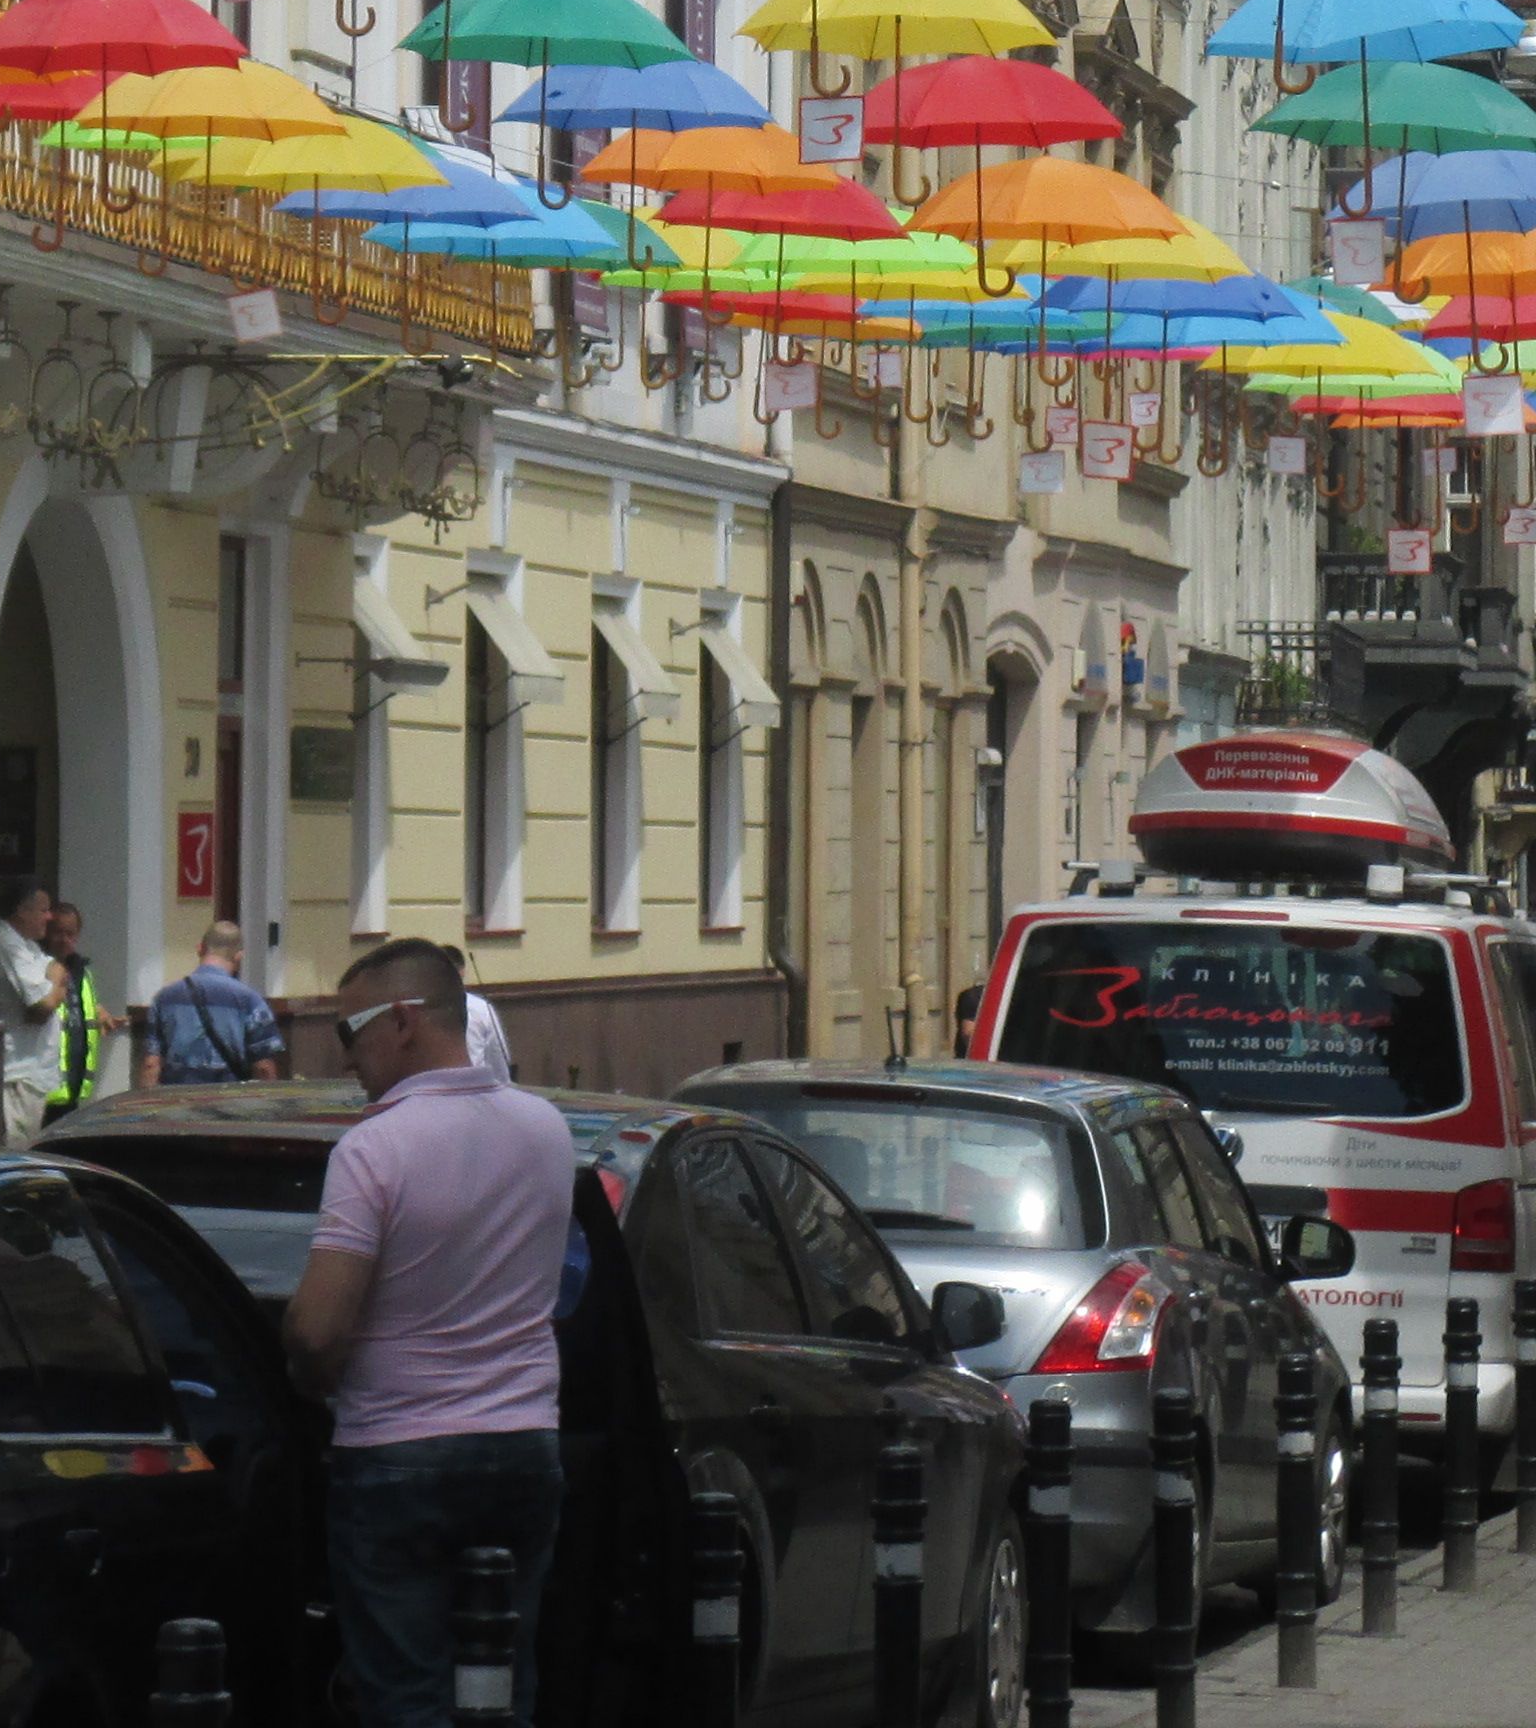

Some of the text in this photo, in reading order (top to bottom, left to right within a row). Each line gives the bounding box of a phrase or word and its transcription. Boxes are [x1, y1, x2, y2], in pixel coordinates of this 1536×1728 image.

[1214, 750, 1310, 765] Перевезення
[1205, 766, 1320, 783] ДНК-матеріалів
[1230, 1037, 1261, 1050] +38
[1324, 1040, 1345, 1053] 09
[1165, 1058, 1214, 1071] e-mail:
